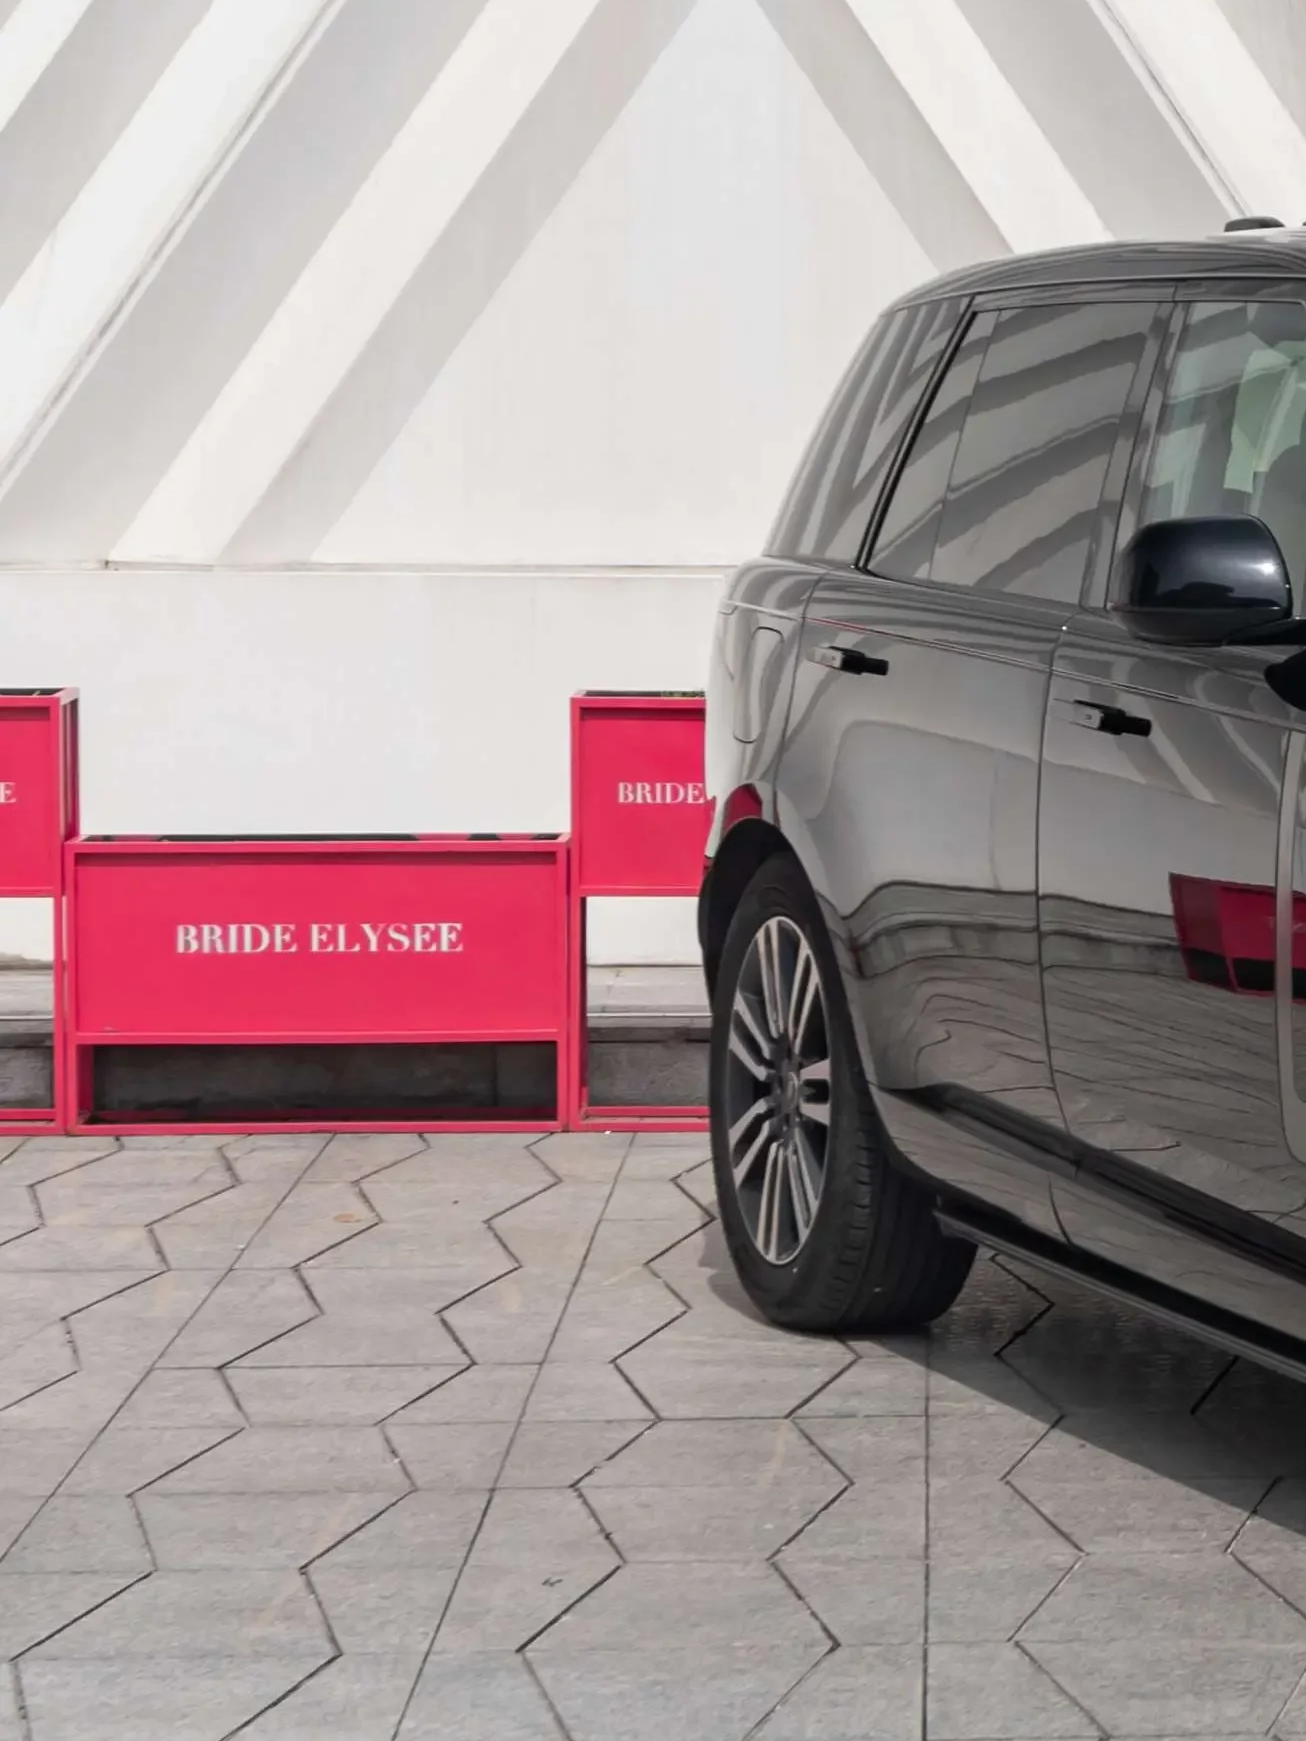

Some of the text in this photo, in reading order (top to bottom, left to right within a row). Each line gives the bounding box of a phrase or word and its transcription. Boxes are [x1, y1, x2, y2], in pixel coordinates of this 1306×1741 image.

[618, 781, 704, 804] BRIDE
[176, 923, 463, 953] BRIDE ELYSEE
